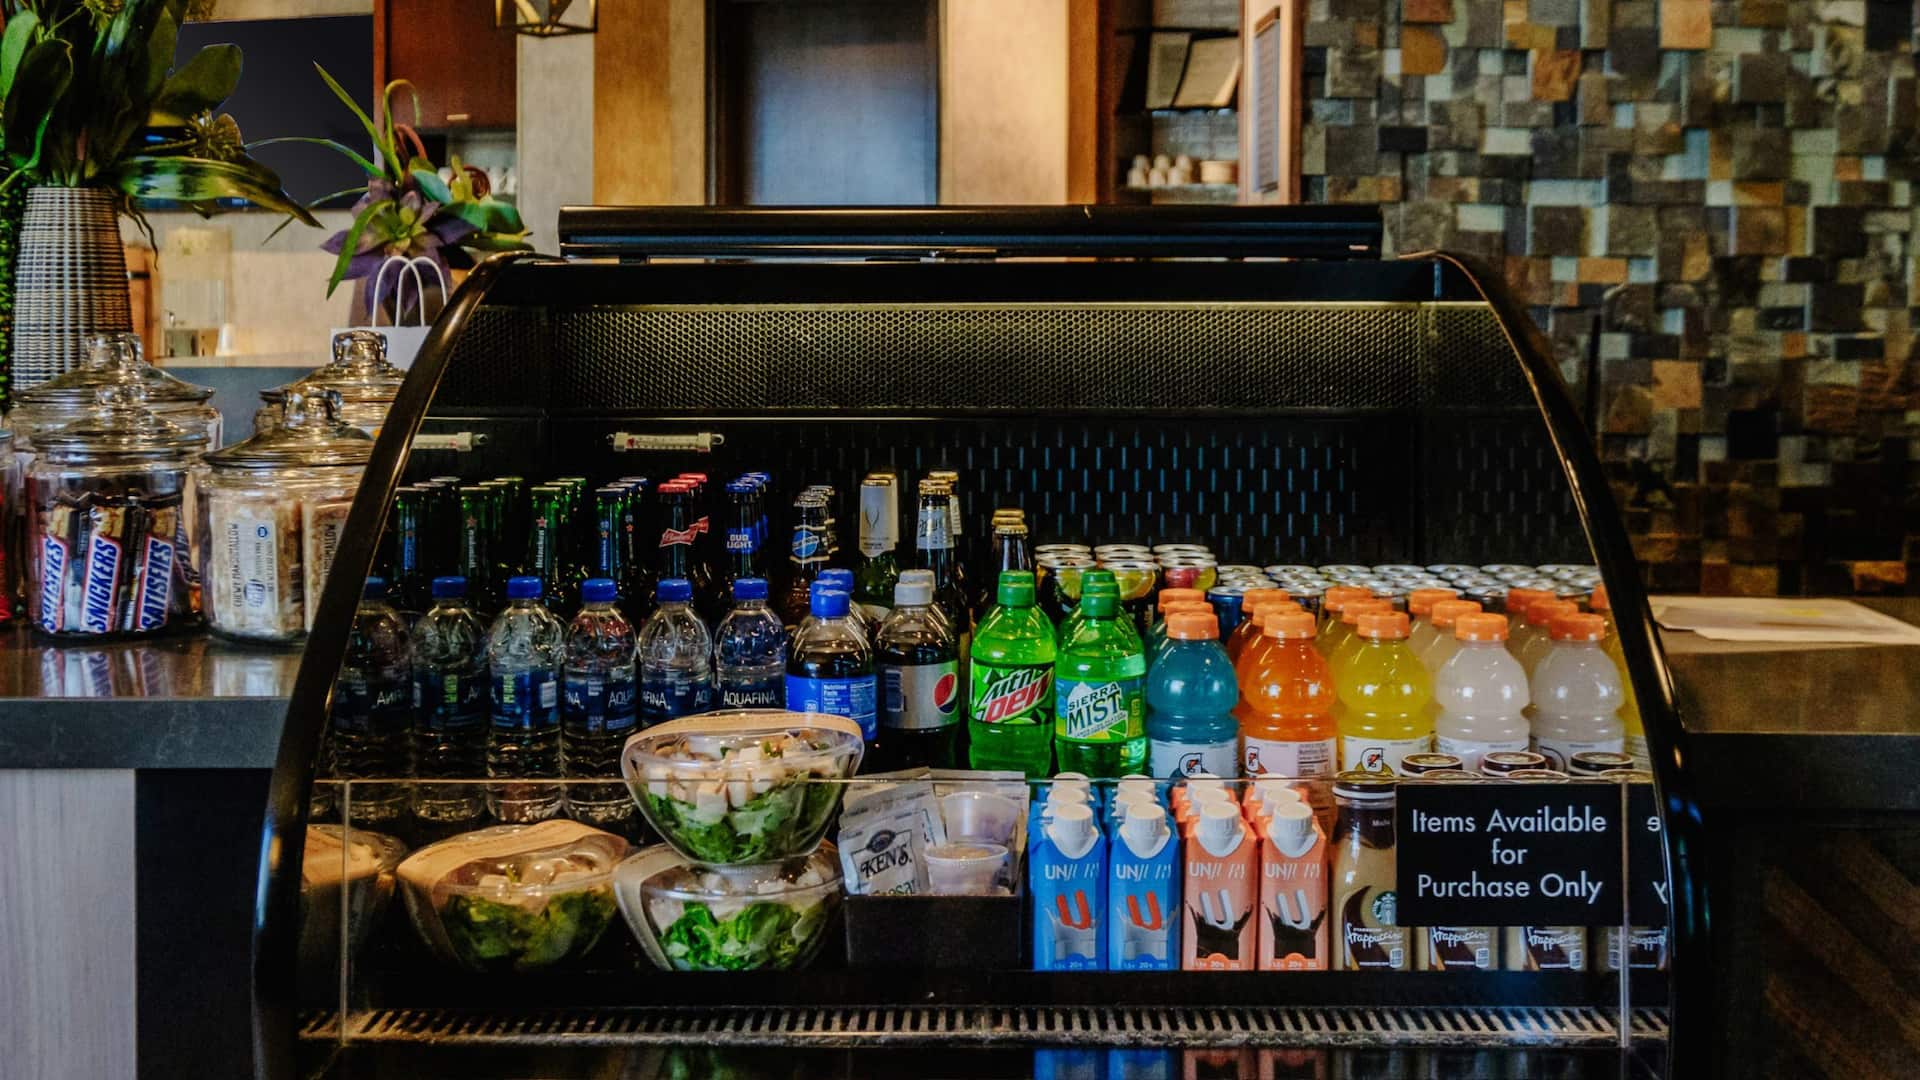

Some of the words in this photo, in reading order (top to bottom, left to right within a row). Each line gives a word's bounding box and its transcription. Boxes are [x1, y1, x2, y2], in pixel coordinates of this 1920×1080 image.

[87, 538, 118, 631] SNICKERS
[141, 539, 172, 630] SATISFIES
[723, 689, 777, 708] AQUAFINA
[1068, 682, 1119, 711] SIERRA
[1068, 690, 1121, 736] MIST
[1413, 809, 1476, 833] Items
[1486, 805, 1607, 833] Available
[1491, 838, 1528, 865] for
[1418, 870, 1530, 898] Purchase
[1540, 870, 1603, 905] Only
